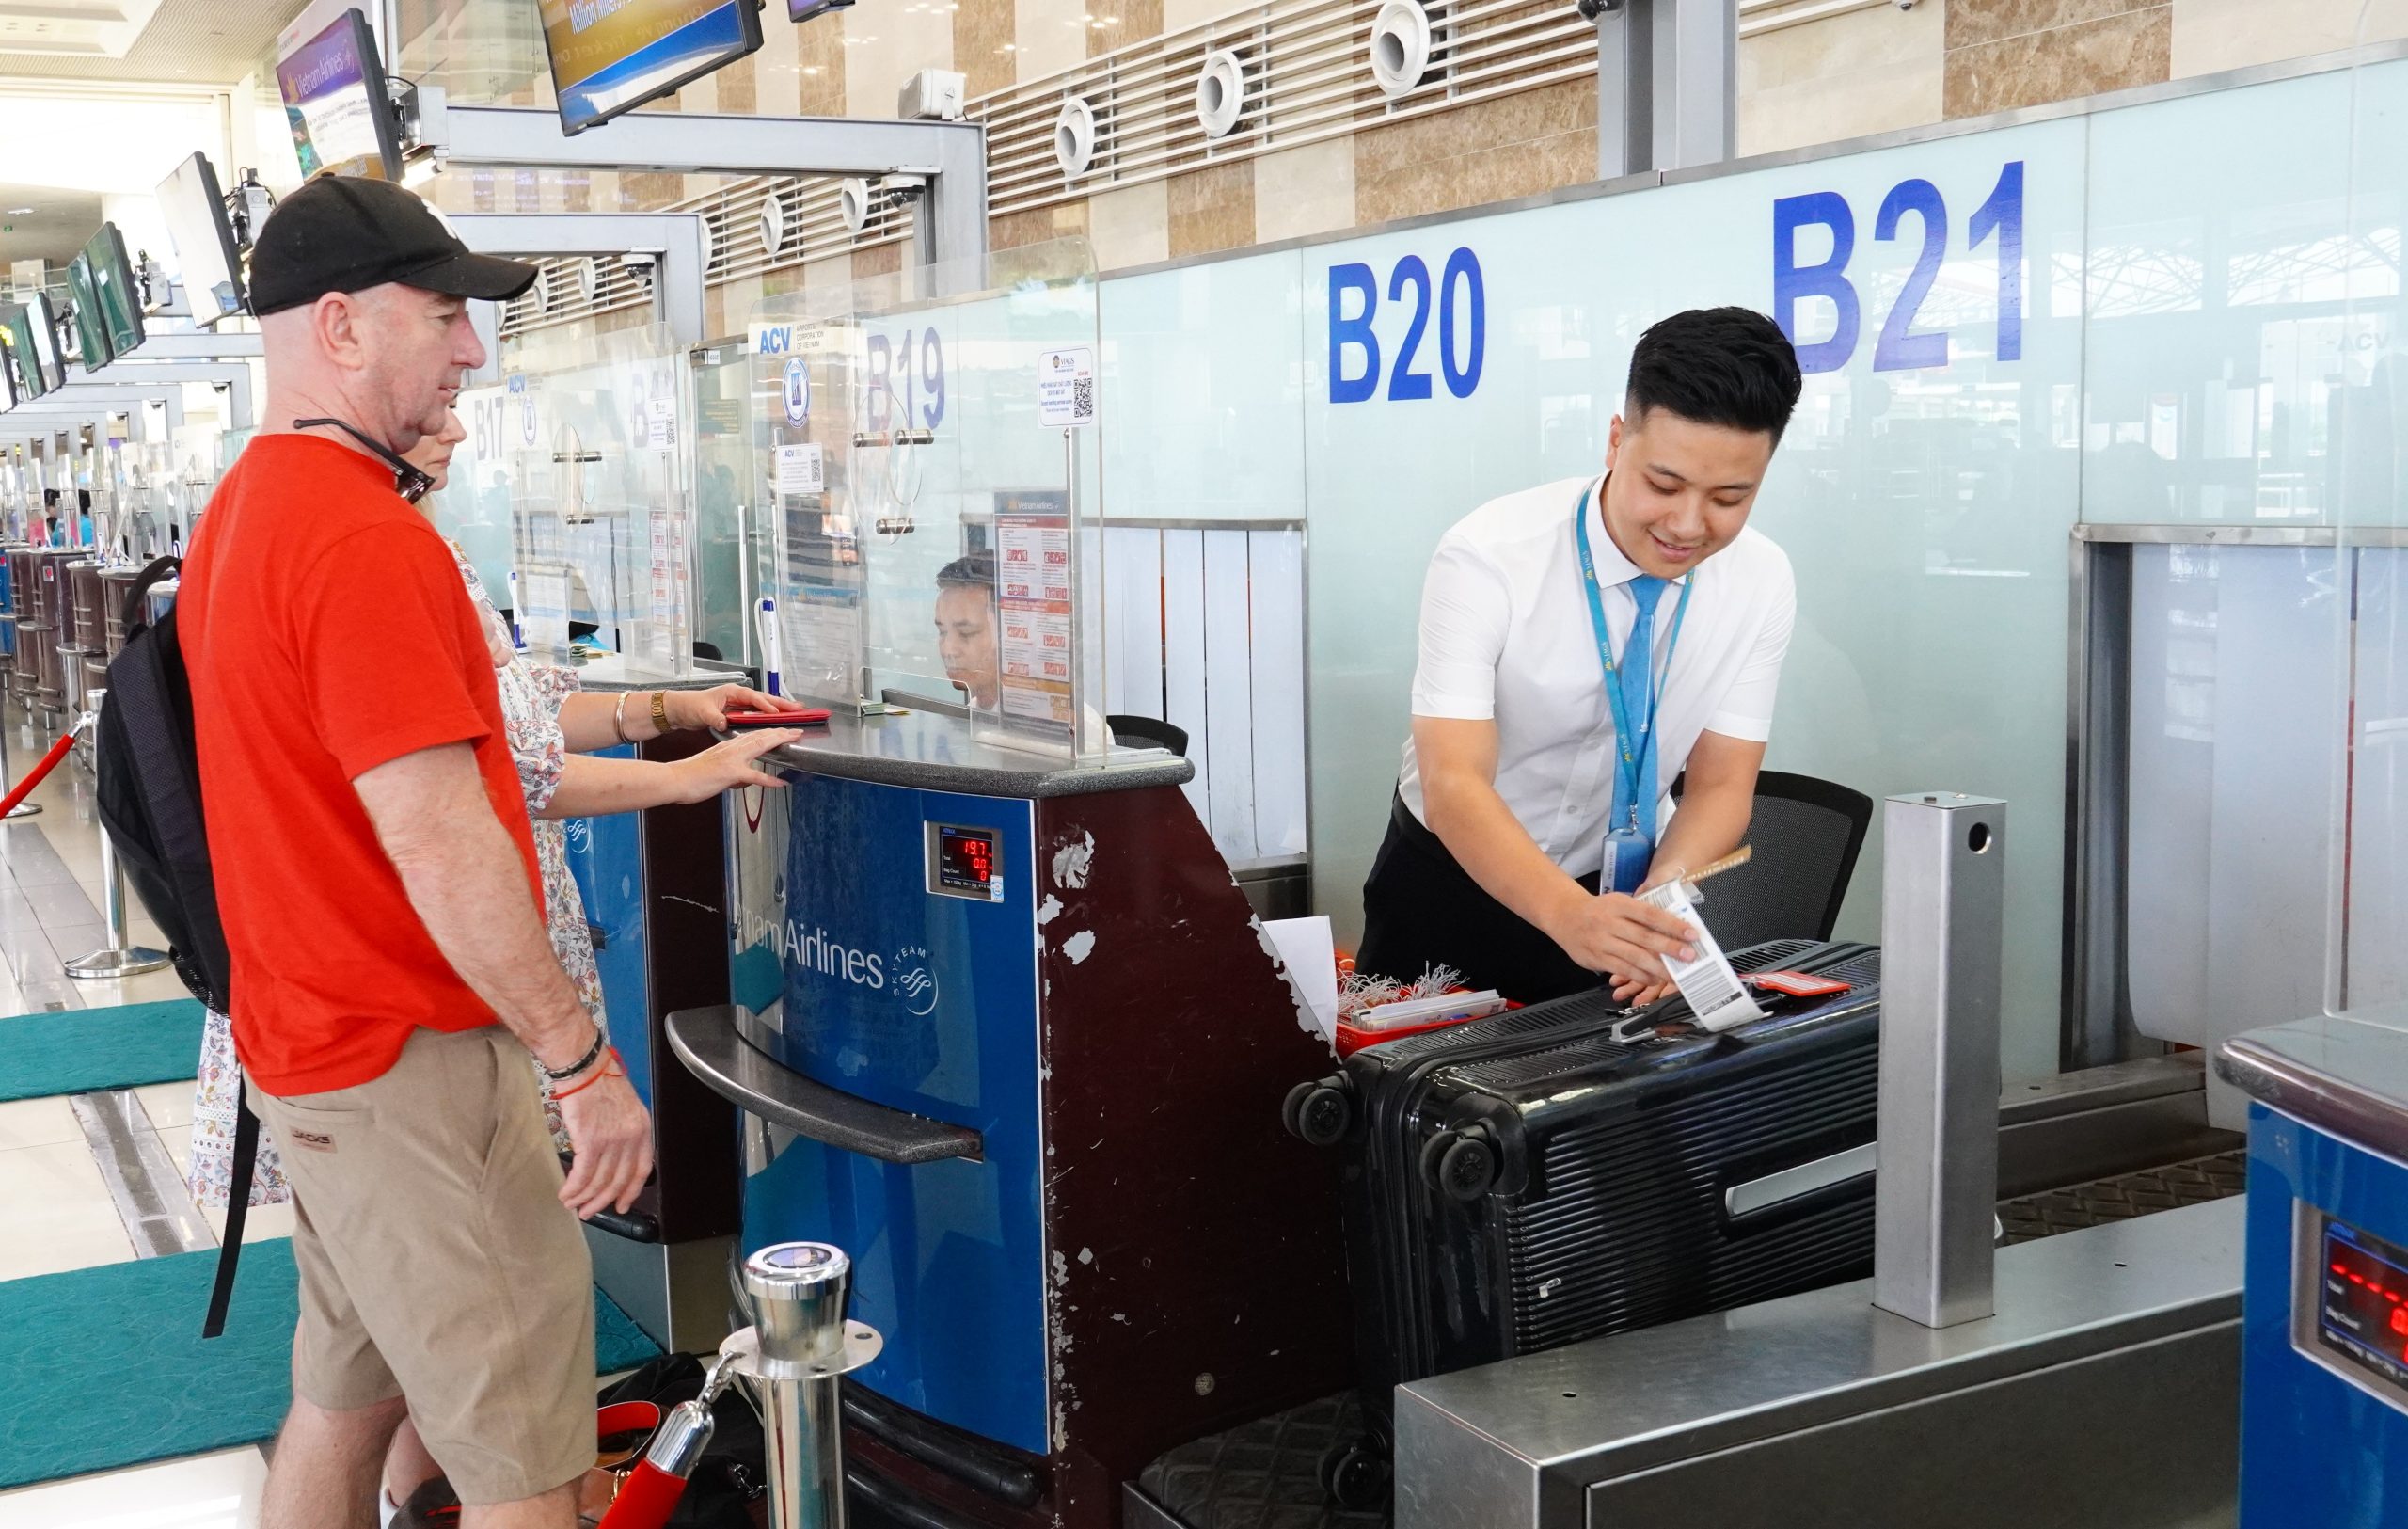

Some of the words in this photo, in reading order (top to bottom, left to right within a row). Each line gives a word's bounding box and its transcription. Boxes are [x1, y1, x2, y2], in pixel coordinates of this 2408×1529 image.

[569, 1, 597, 35] Million
[295, 68, 322, 98] Vietnam
[319, 52, 344, 81] Airlines
[1774, 160, 2025, 374] B21
[760, 326, 792, 355] ACV
[1329, 247, 1485, 406] B20
[509, 374, 526, 394] ACV
[867, 327, 945, 433] B19
[474, 396, 504, 460] B17
[784, 449, 795, 457] ACV
[964, 841, 986, 856] 19.7
[973, 857, 987, 869] 0.0
[980, 870, 987, 881] 0
[784, 918, 884, 989] Airlines
[891, 945, 927, 996] SKYTEAM
